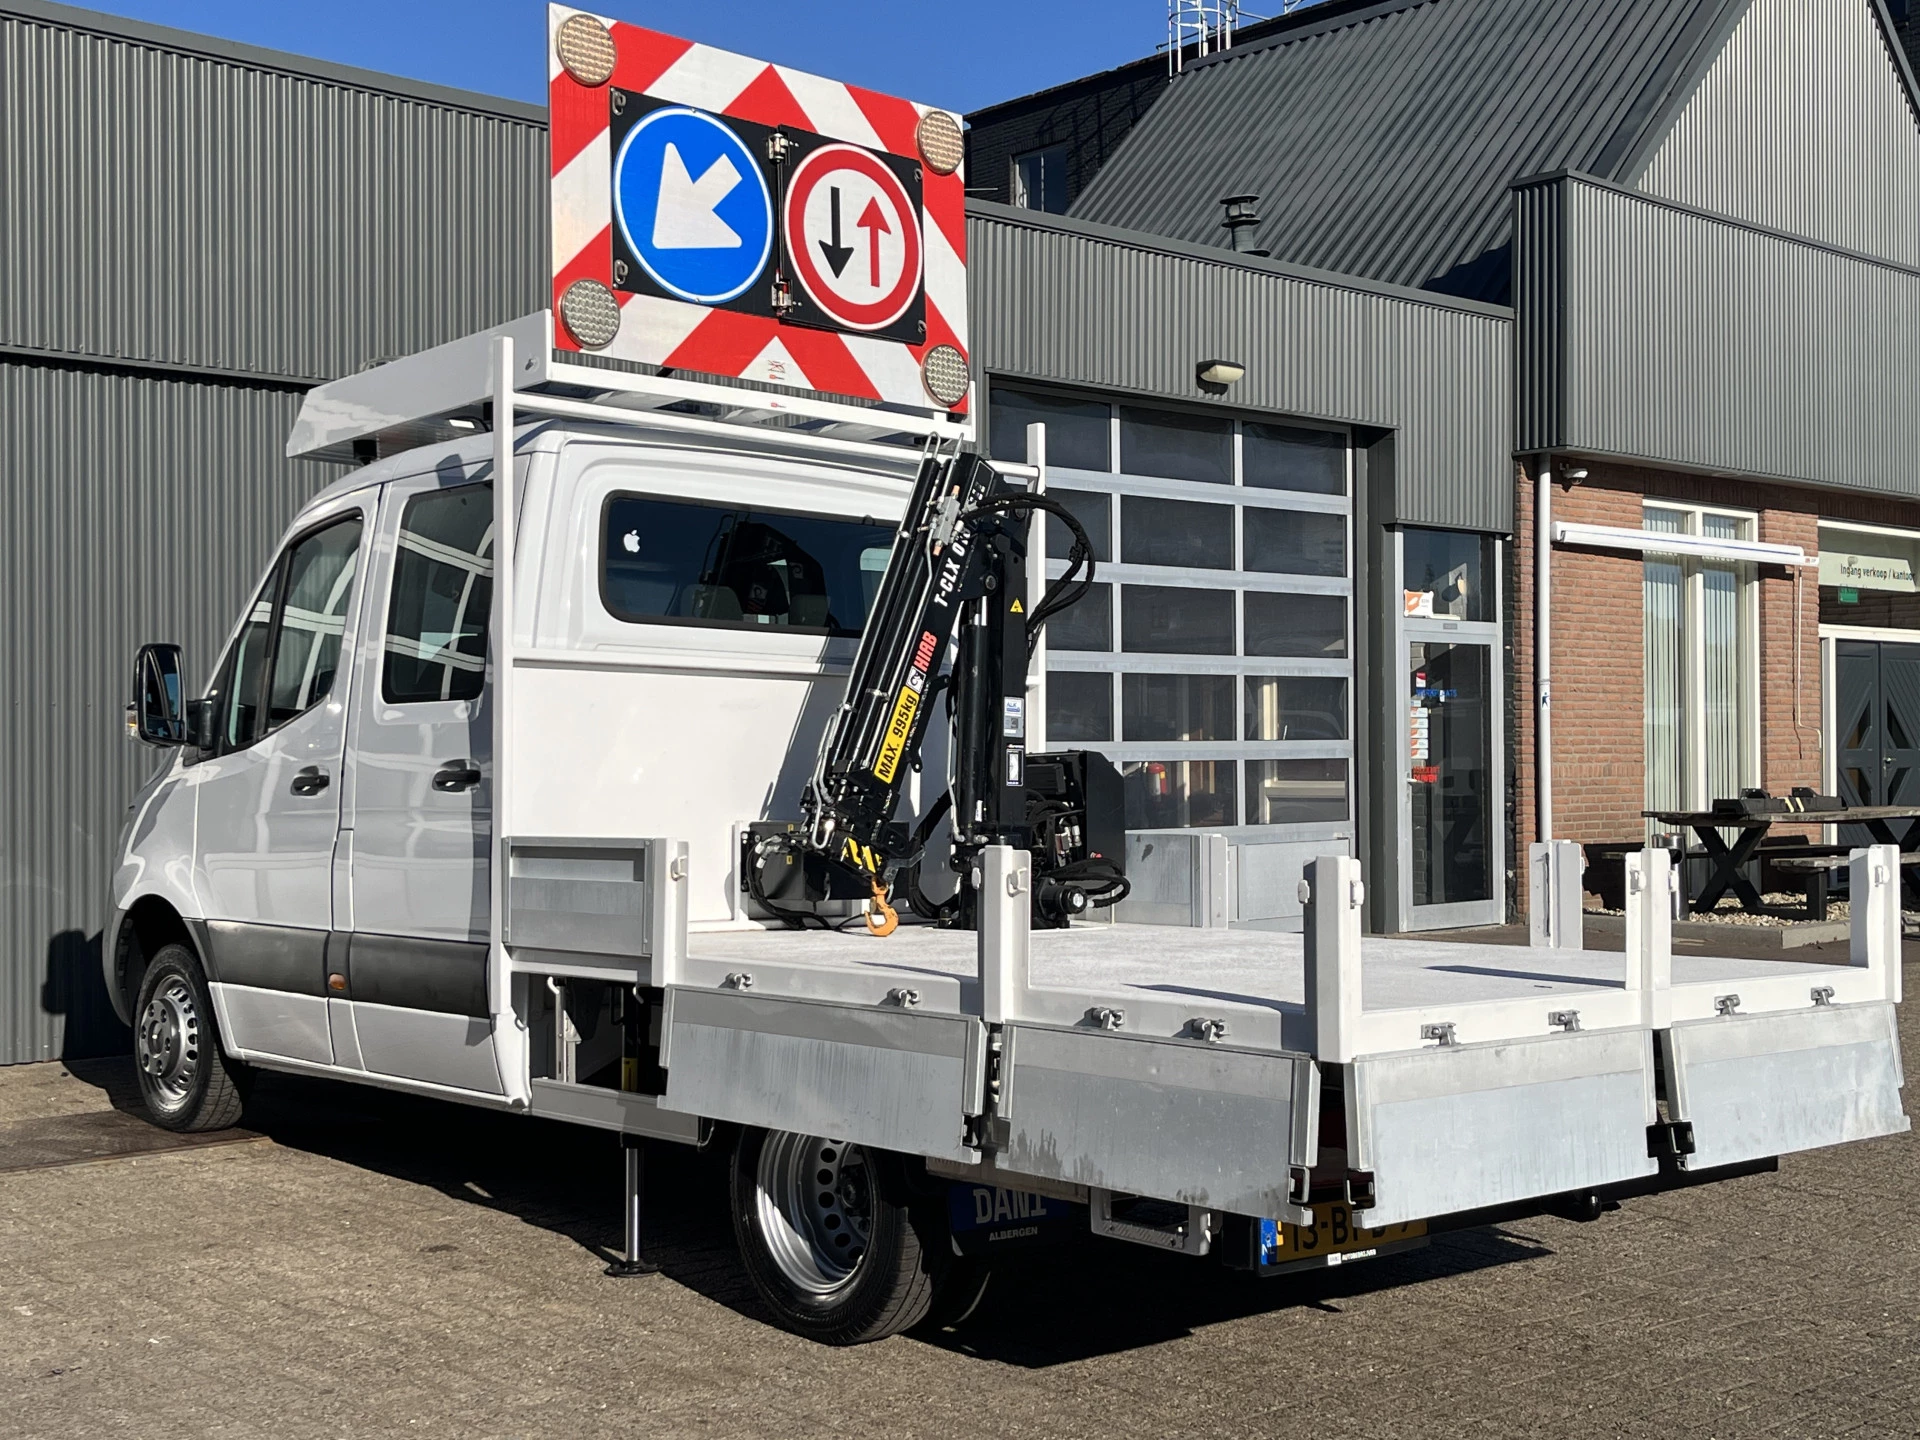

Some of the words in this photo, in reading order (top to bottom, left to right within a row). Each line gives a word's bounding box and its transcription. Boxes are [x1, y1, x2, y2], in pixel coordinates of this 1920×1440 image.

[934, 557, 961, 608] T-CLX
[1840, 563, 1861, 579] Ingang
[1863, 566, 1887, 580] verkoop
[914, 630, 937, 672] HIAB
[878, 742, 900, 778] MAX.
[893, 693, 917, 738] 995kg
[972, 1187, 1047, 1225] DANI
[988, 1226, 1038, 1241] ALBERGEN
